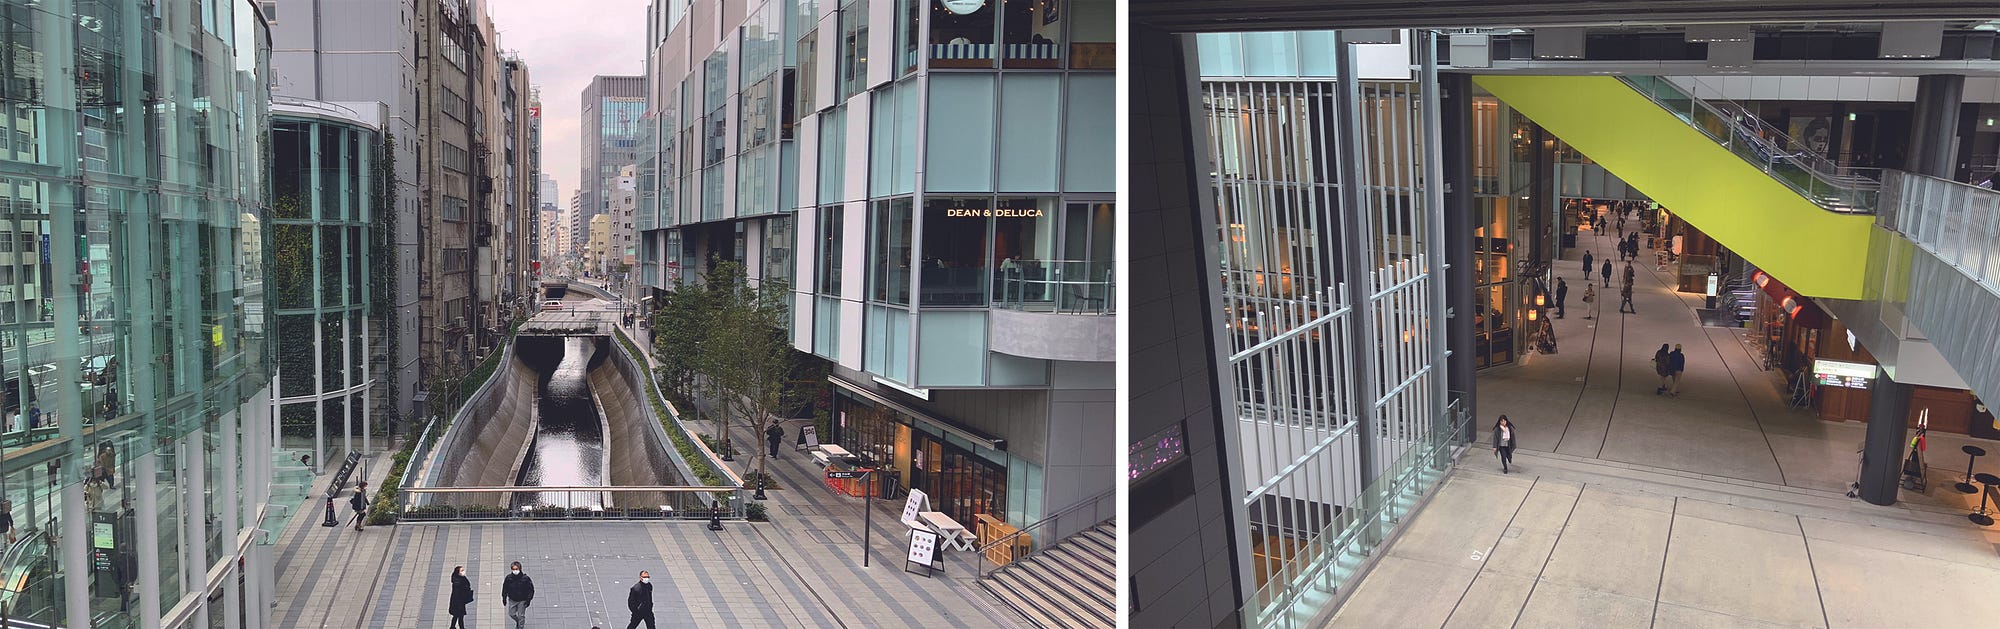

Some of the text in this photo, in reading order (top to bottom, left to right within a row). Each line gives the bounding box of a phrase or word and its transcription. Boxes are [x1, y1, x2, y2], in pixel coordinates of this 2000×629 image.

[947, 209, 1044, 217] DEAN & DELUCA
